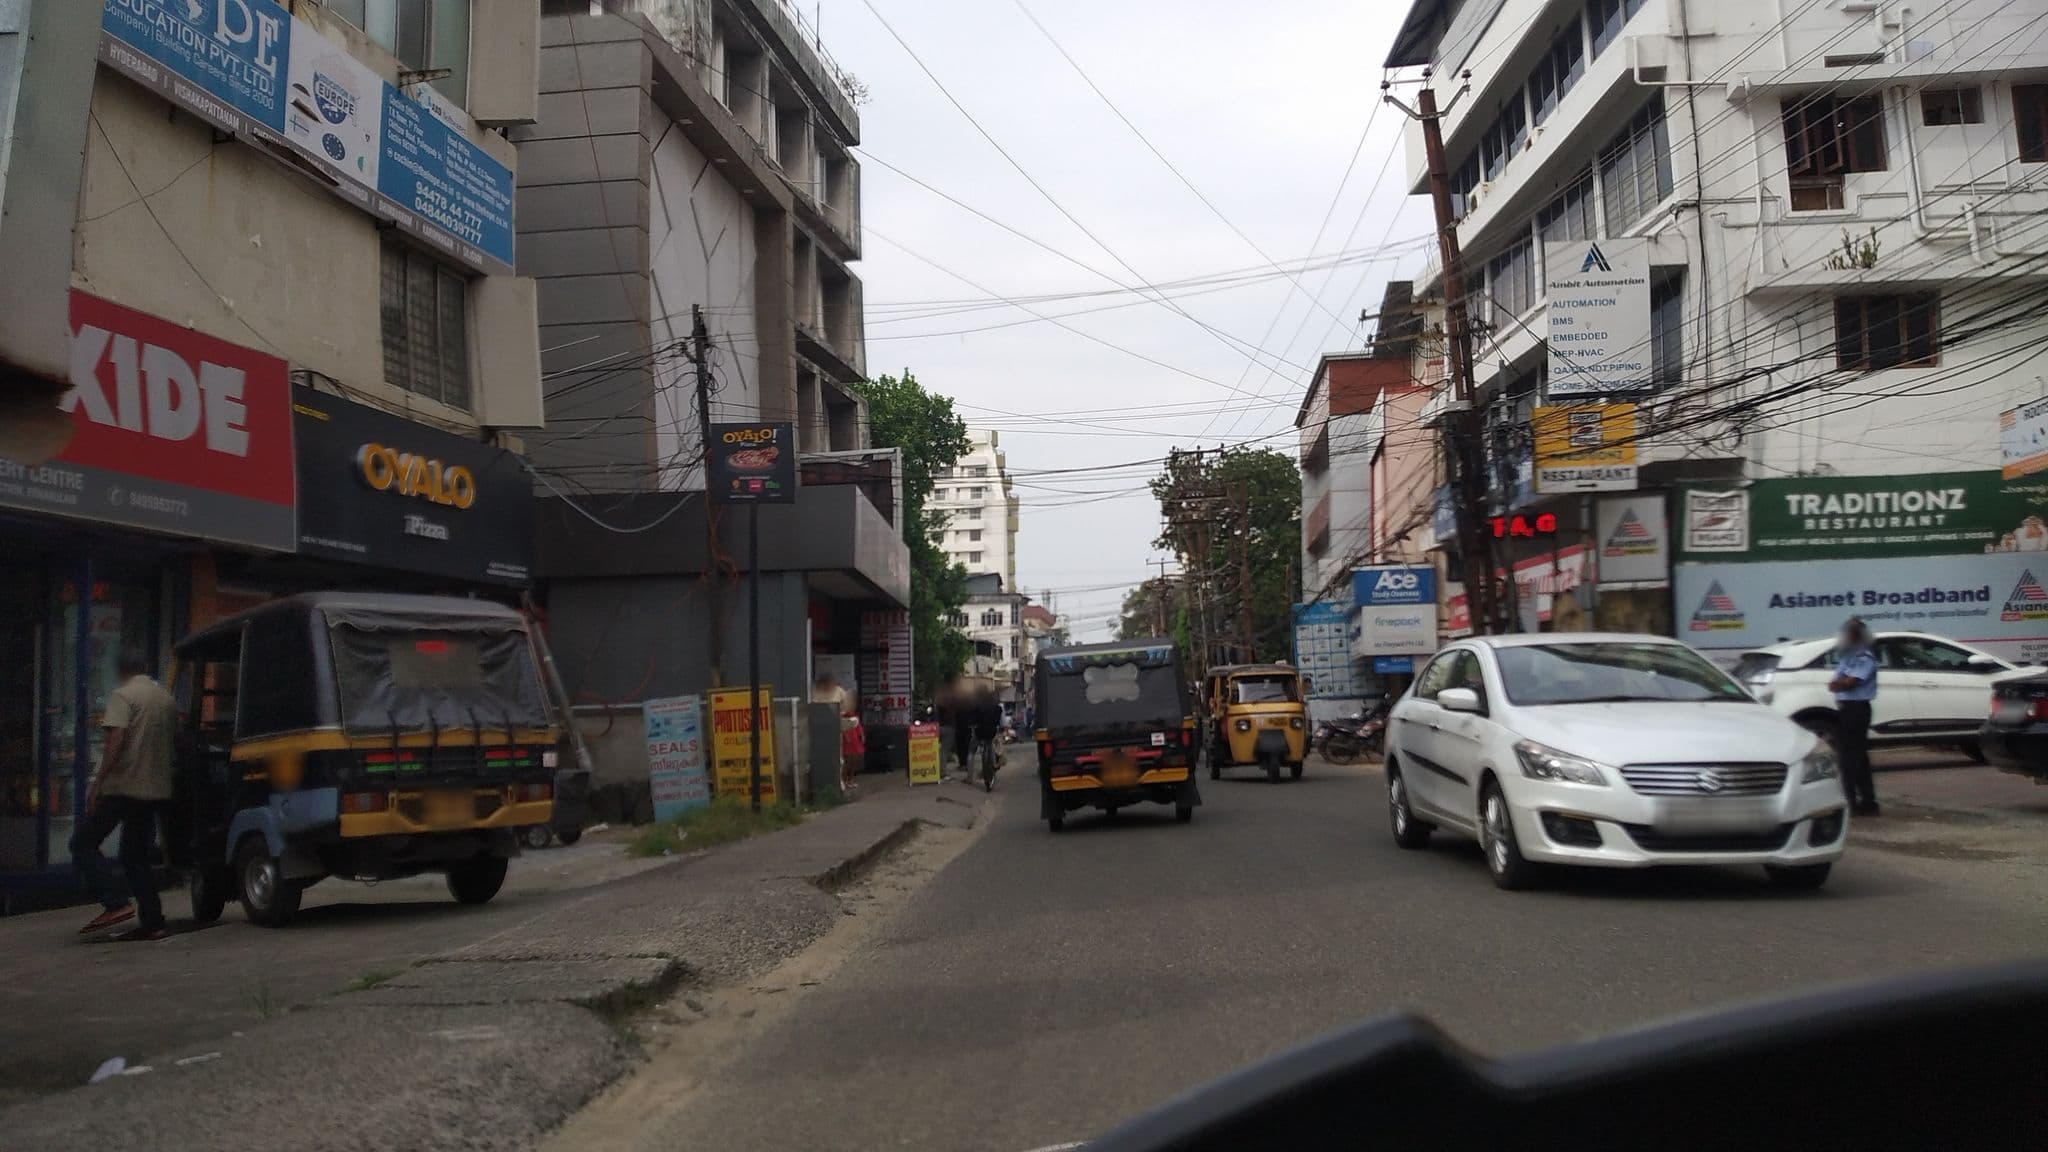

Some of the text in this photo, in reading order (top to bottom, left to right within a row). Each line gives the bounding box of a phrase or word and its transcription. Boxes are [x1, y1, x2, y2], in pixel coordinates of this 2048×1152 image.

[155, 30, 192, 63] Building
[251, 87, 274, 110] 2000
[318, 84, 354, 116] EUROPE
[415, 180, 447, 209] 94478
[449, 204, 462, 218] 44
[464, 211, 482, 230] 777
[1550, 277, 1645, 289] Ambit Automation
[1552, 298, 1616, 309] AUTOMATION
[1552, 317, 1574, 326] BMS
[1553, 332, 1608, 342] EMBEDDED
[357, 442, 476, 509] OYALO
[1541, 468, 1632, 482] RESTAURANT
[1784, 488, 1967, 516] TRADITIONZ
[405, 514, 450, 541] Pizza
[1804, 514, 1946, 531] RESTAURANT
[1373, 570, 1418, 590] Ace
[1372, 590, 1420, 599] Study Overseas
[1768, 585, 1990, 609] Asianet Broadband
[2003, 600, 2048, 612] Asiane
[649, 738, 698, 757] SEALS
